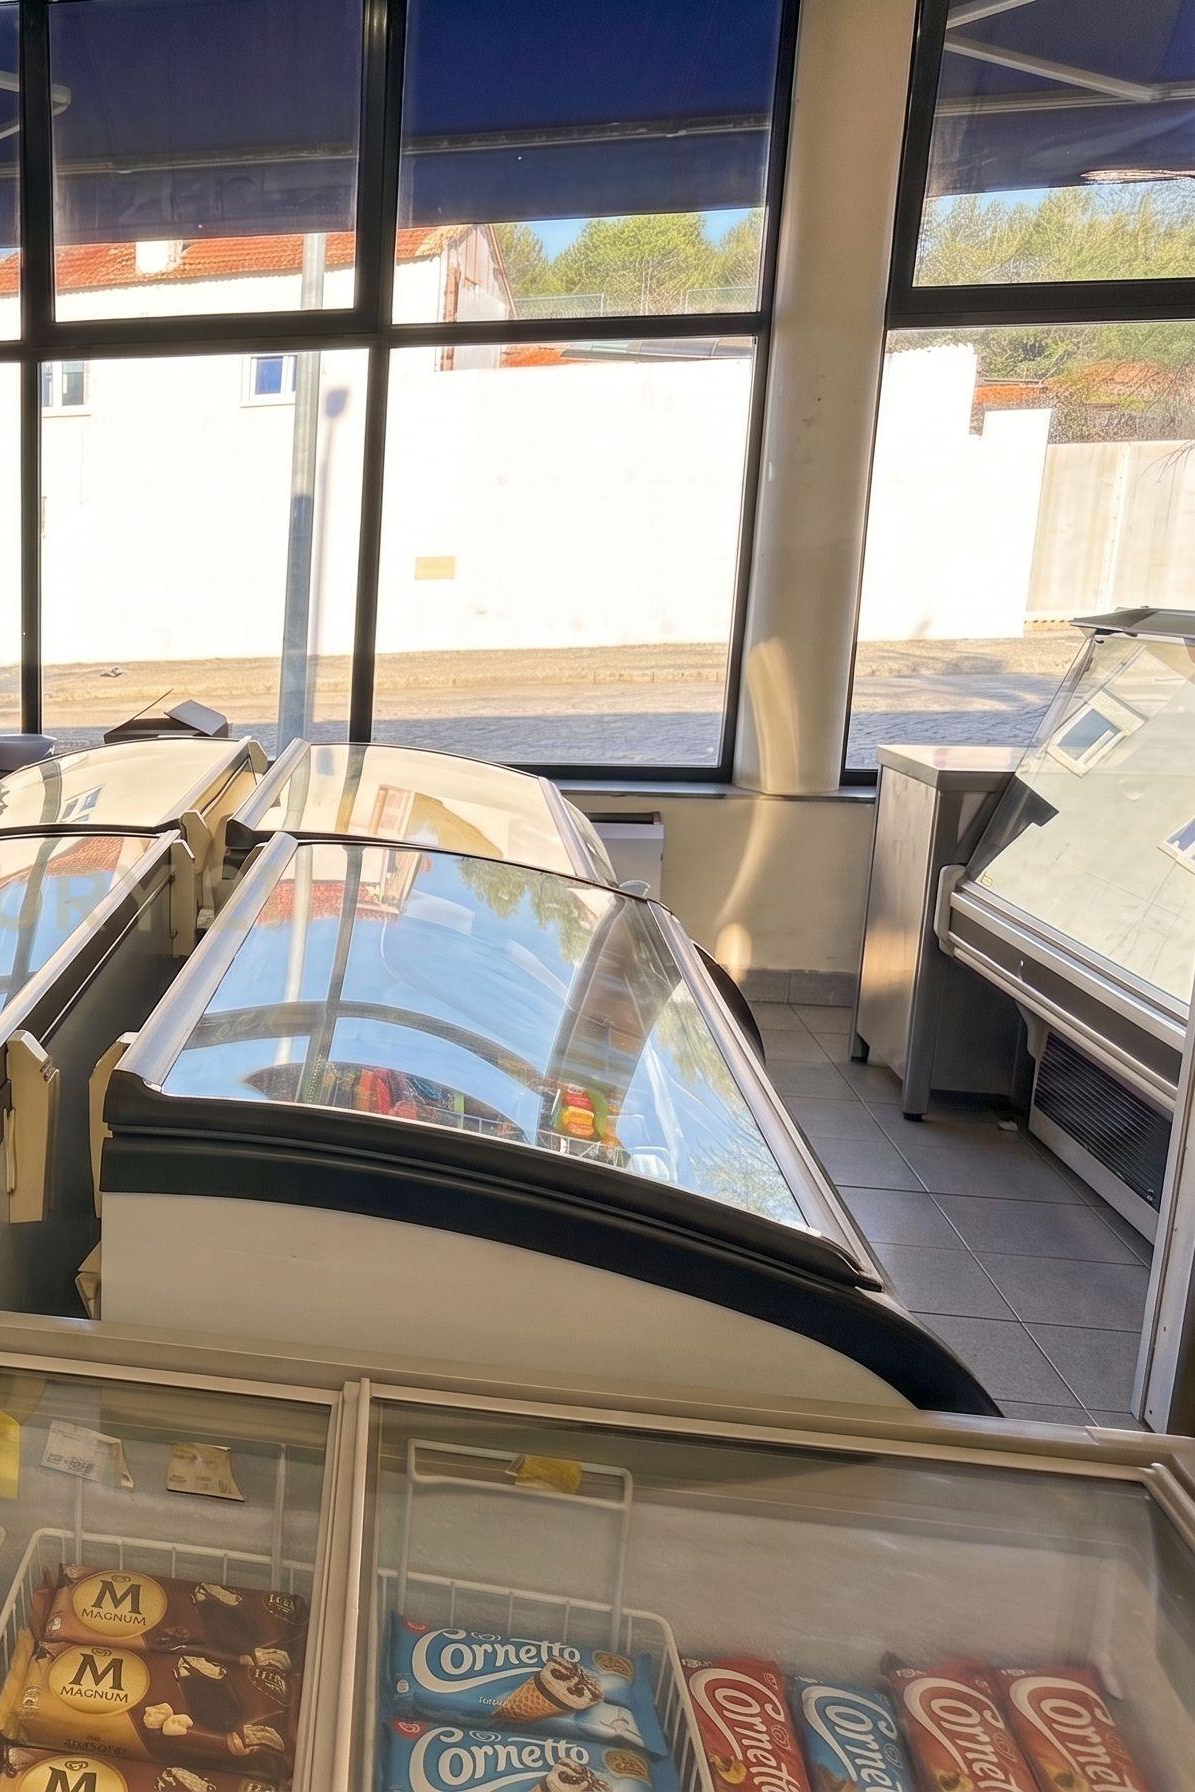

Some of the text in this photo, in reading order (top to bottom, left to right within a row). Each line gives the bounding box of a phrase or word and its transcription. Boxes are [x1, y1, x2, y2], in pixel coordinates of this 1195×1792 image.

[90, 1579, 143, 1615] M
[81, 1608, 147, 1627] MAGNUM
[68, 1652, 125, 1692] M
[411, 1628, 582, 1694] Cornetto
[60, 1685, 130, 1704] MAGNUM
[409, 1726, 590, 1792] Cornetto
